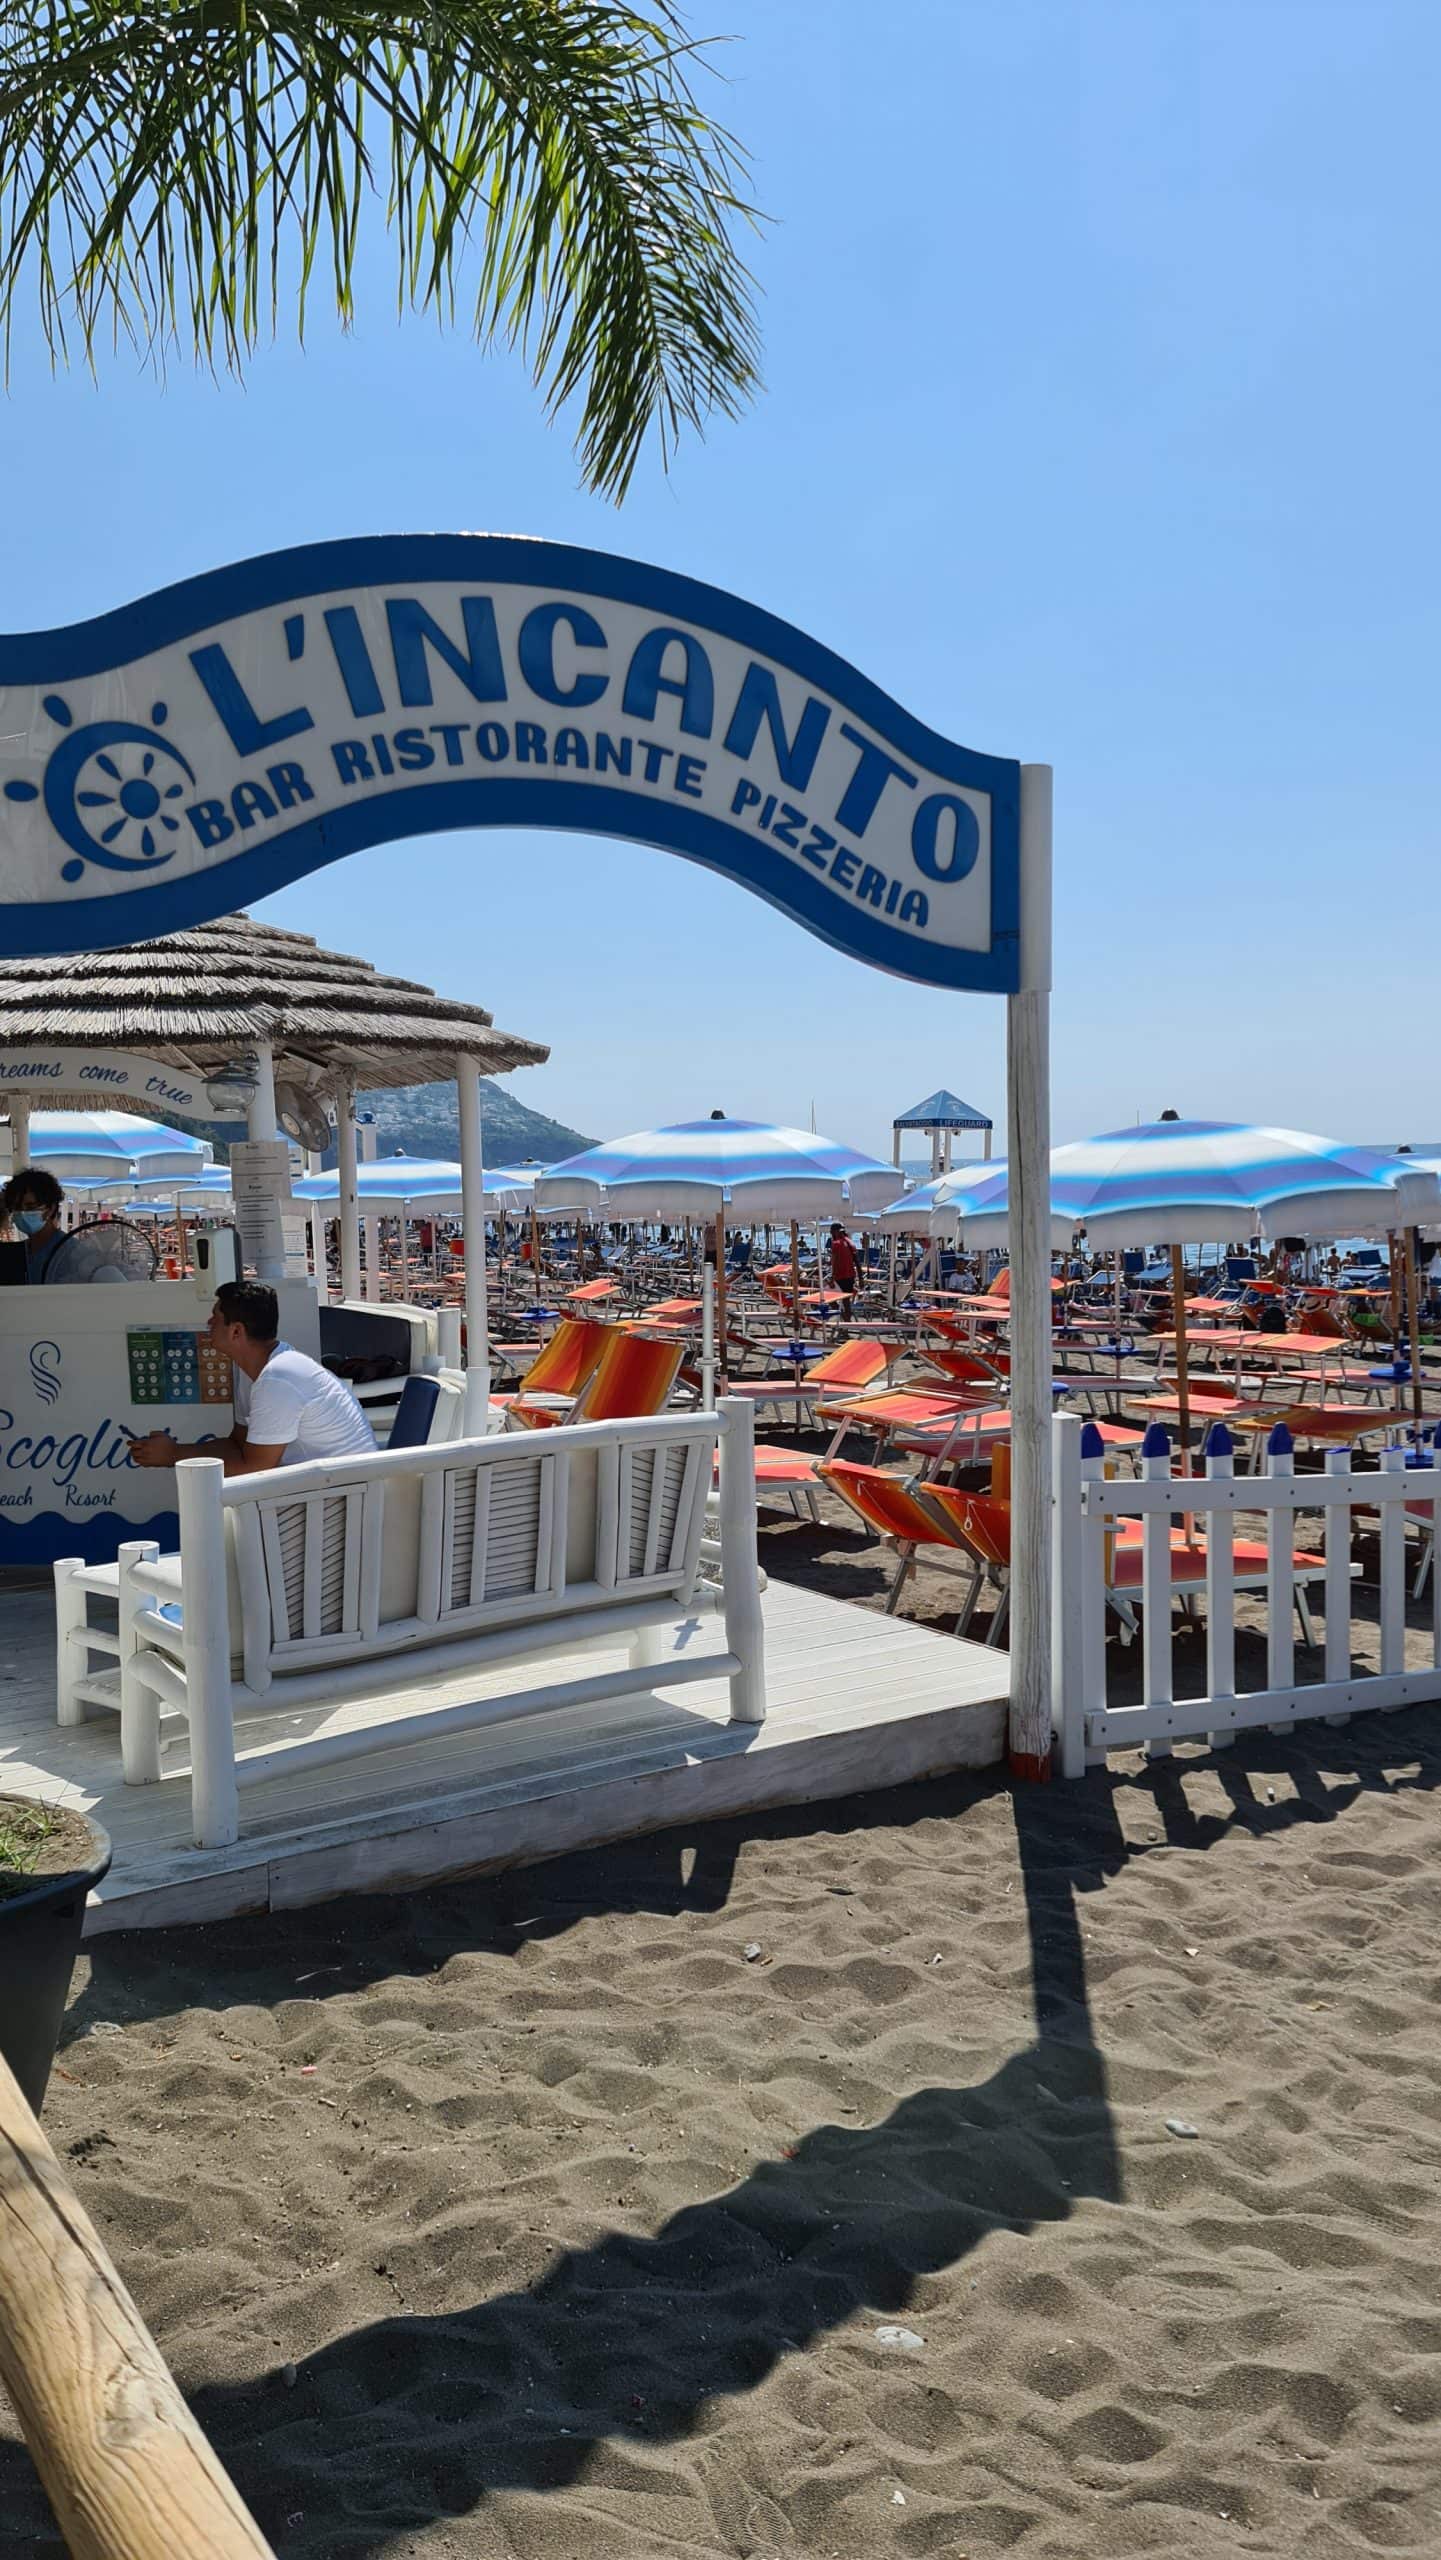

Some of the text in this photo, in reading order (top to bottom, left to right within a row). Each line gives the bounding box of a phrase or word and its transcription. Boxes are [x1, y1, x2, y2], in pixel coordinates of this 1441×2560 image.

[188, 596, 980, 883] L'INCANTO
[185, 721, 929, 929] BAR RISTORANTE PIZZERIA
[79, 1064, 129, 1084] come
[145, 1076, 193, 1105] true
[939, 1119, 989, 1129] LIFEGUARD
[65, 1484, 117, 1506] Resort
